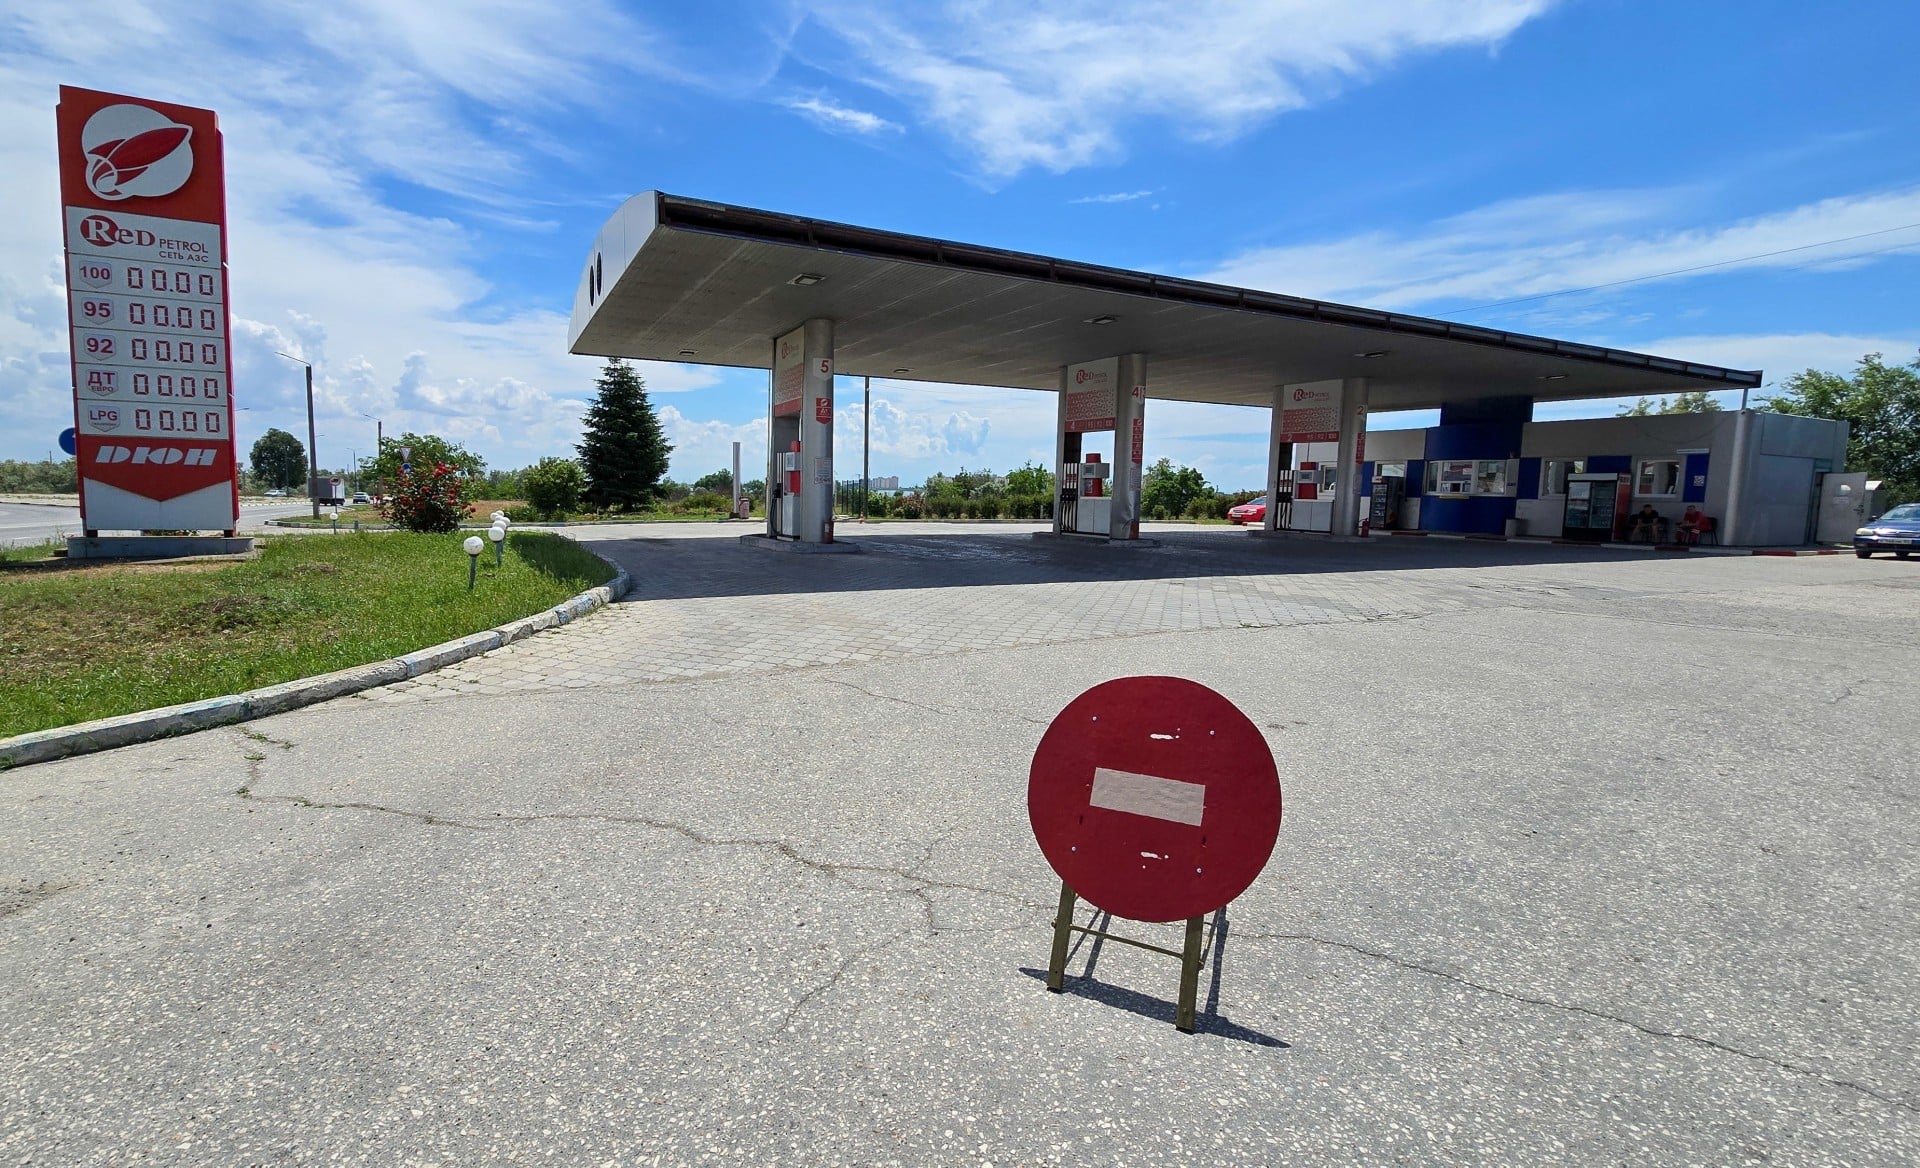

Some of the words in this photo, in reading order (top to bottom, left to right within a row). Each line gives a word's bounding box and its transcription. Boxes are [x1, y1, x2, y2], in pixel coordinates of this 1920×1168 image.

[159, 238, 209, 254] PETROL
[158, 250, 184, 261] СЕТЬ
[187, 253, 209, 263] АЗС
[80, 265, 111, 280] 100
[83, 301, 111, 318] 95
[86, 337, 113, 354] 92
[820, 359, 829, 373] 5
[88, 371, 115, 386] ДТ
[1132, 387, 1139, 398] 4
[90, 410, 118, 421] LPG
[1357, 405, 1364, 415] 2
